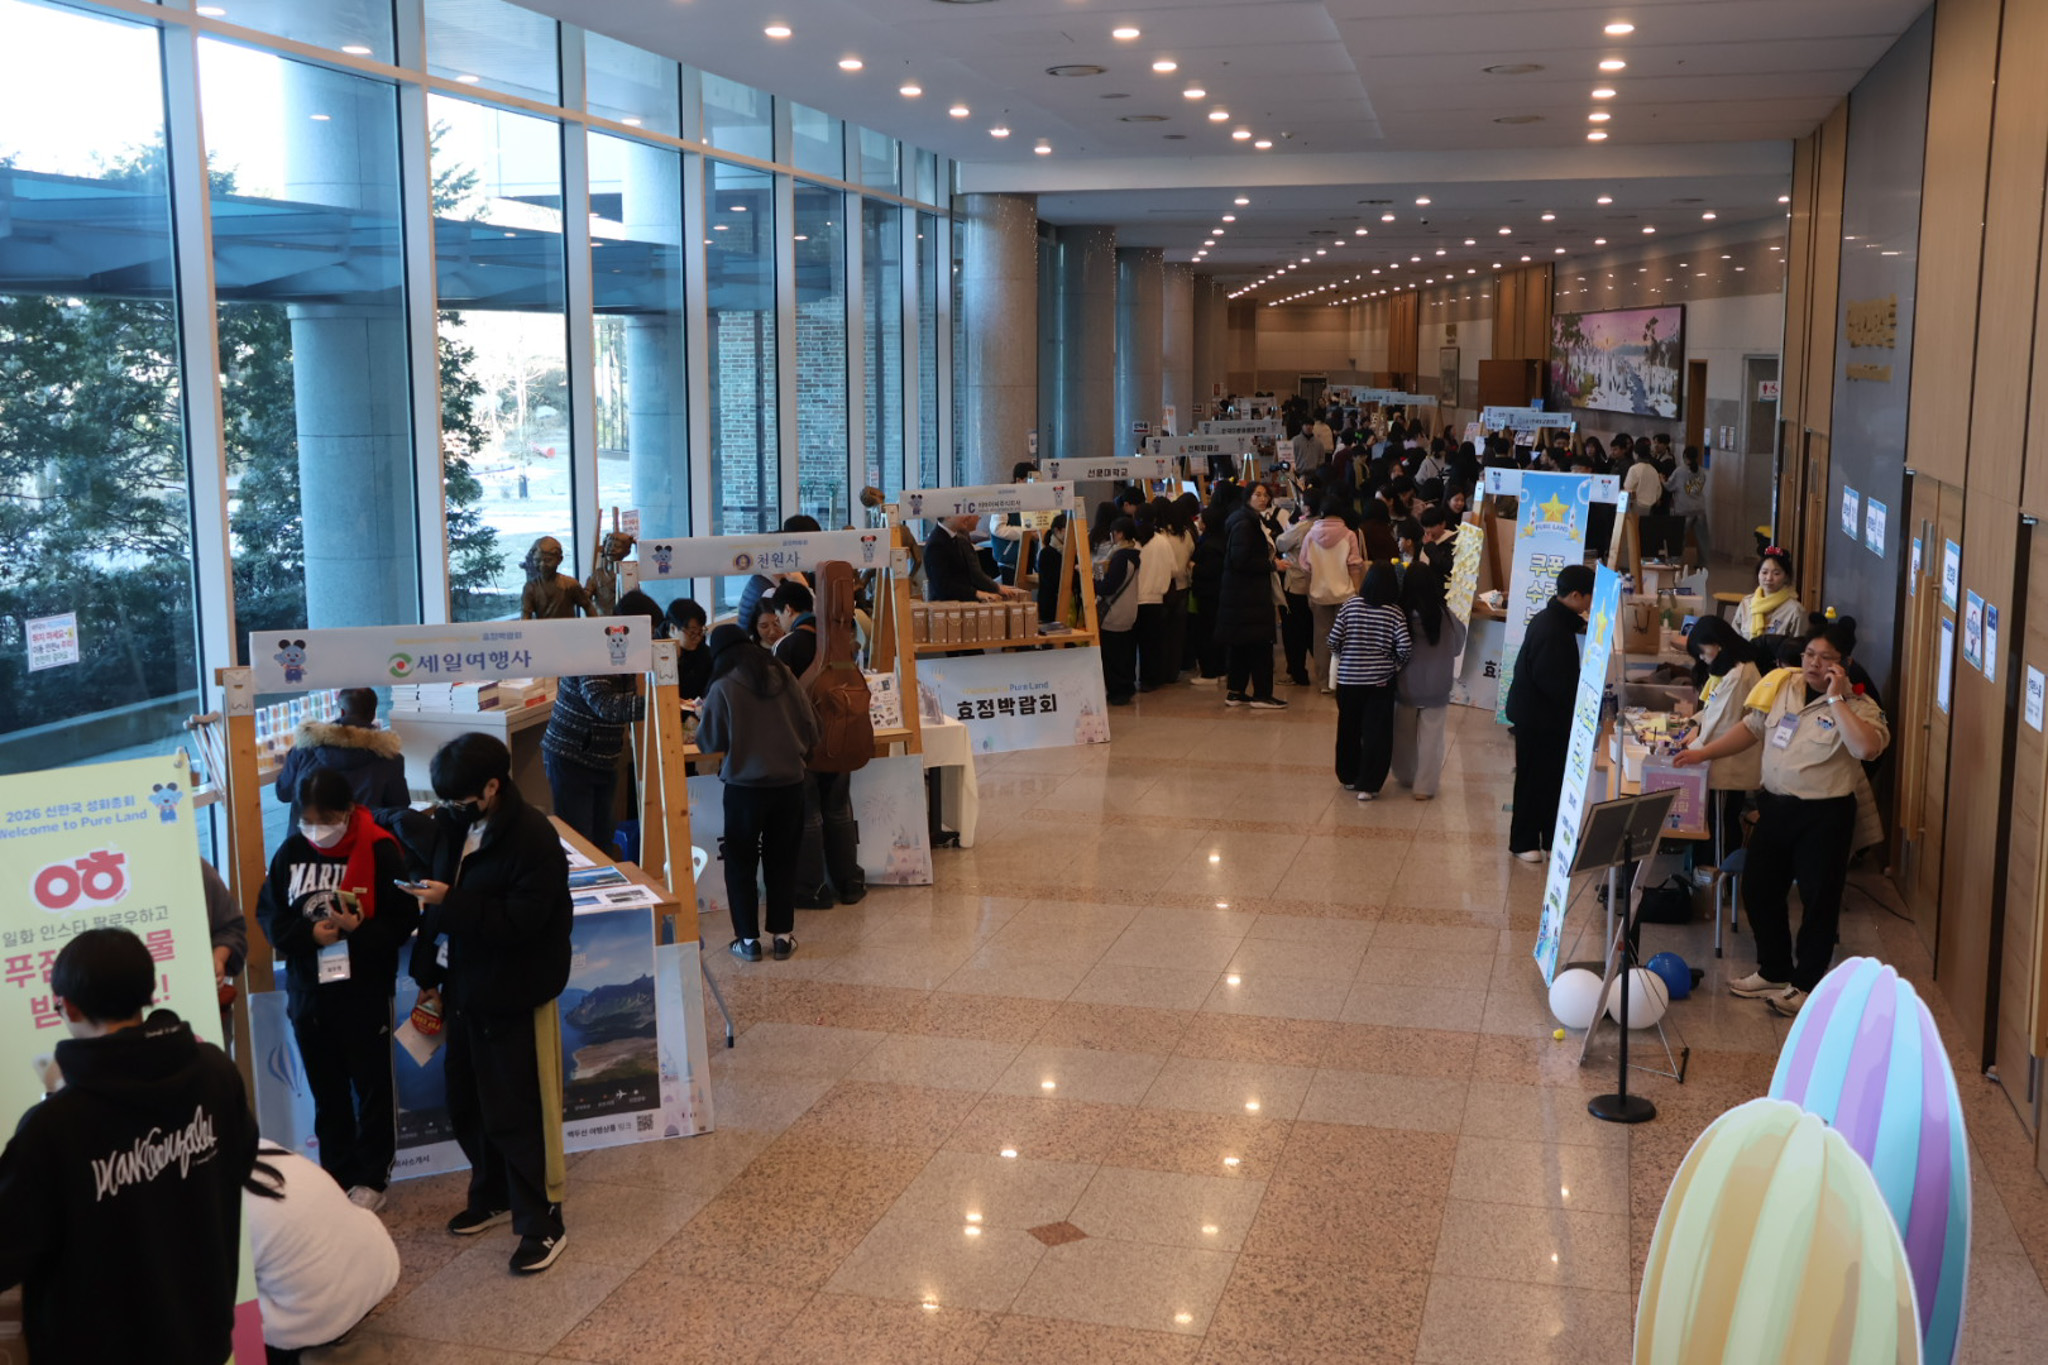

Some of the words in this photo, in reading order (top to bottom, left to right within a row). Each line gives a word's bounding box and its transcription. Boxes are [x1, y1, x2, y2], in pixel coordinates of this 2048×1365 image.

[1087, 467, 1128, 478] 선문대학교
[757, 551, 801, 569] 천원사
[1529, 553, 1565, 578] 쿠폰
[416, 649, 532, 673] 세일여행사
[956, 693, 1058, 721] 효정박람회
[0, 824, 59, 840] Welcome
[63, 818, 78, 831] to
[81, 814, 112, 828] Pure
[116, 809, 148, 823] Land
[6, 808, 41, 823] 2026
[3, 929, 34, 948] 일화
[40, 919, 87, 942] 인스타
[93, 905, 169, 929] 팔로우하고
[567, 1128, 588, 1138] 백두산
[589, 1124, 617, 1135] 여행상품
